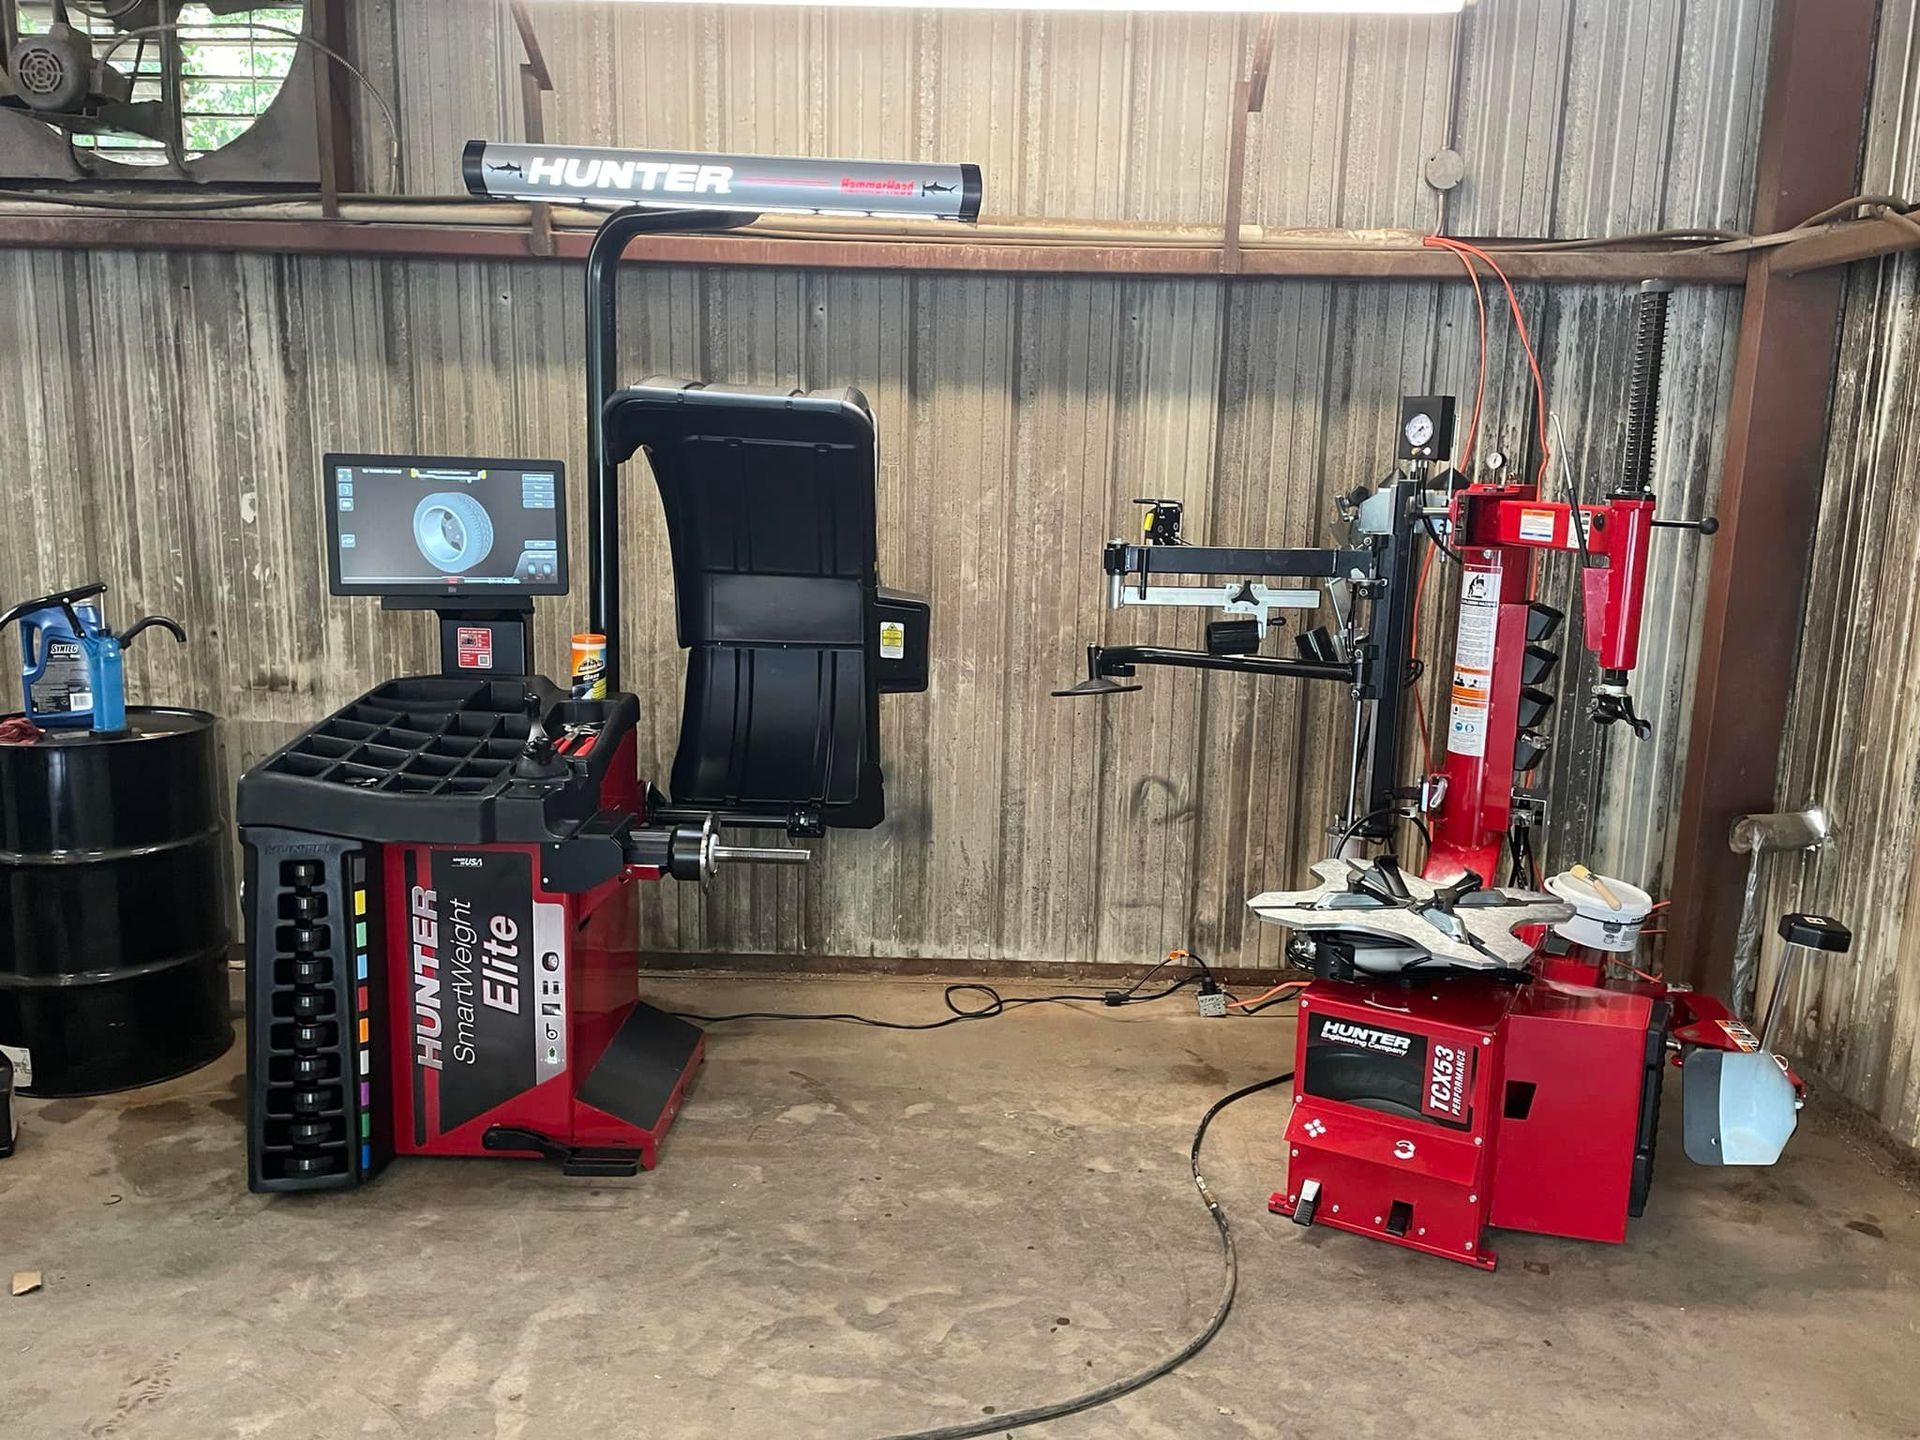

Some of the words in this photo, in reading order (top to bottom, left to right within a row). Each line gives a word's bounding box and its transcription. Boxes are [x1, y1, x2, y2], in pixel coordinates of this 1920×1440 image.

[527, 157, 733, 194] HUNTER
[411, 885, 444, 1071] HUNTER
[449, 898, 478, 1065] SmartWeight
[481, 914, 520, 1015] Elite
[1320, 1031, 1367, 1048] Engineering
[1367, 1041, 1408, 1056] Company
[1322, 1020, 1411, 1050] HUNTER
[1429, 1044, 1455, 1112] TCX53
[1451, 1048, 1466, 1116] PERFORMANCE
